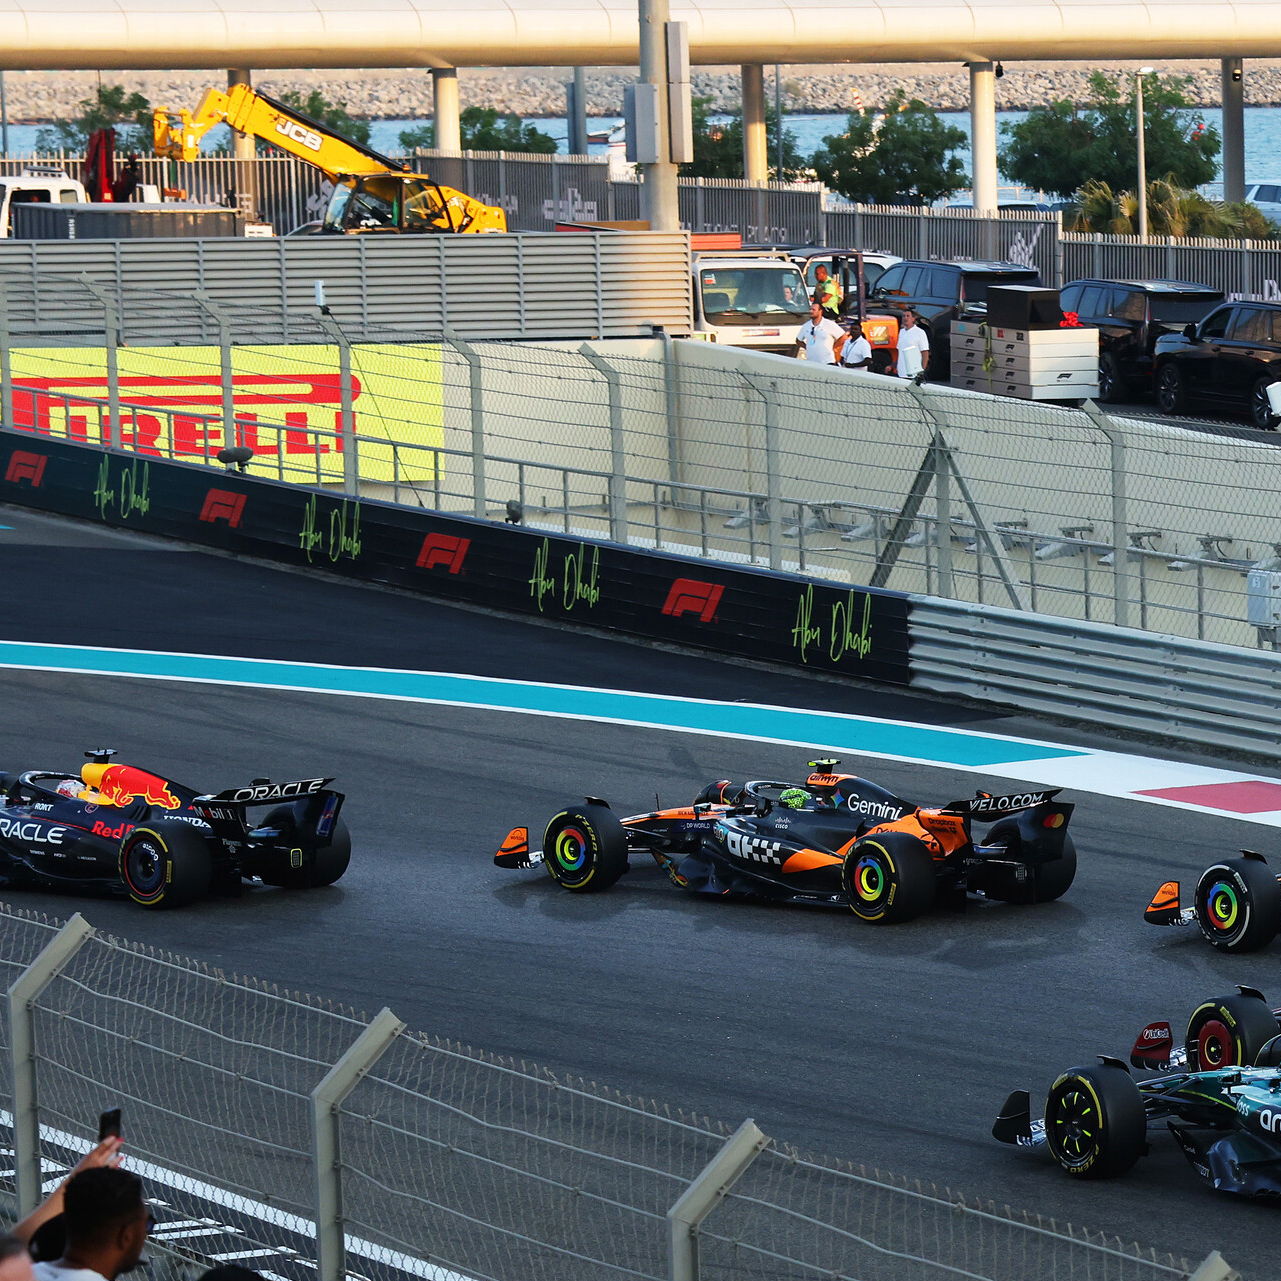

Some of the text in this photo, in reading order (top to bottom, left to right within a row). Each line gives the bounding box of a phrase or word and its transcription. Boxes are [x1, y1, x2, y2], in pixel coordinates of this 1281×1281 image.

[275, 118, 323, 151] JCB
[5, 450, 48, 487] F1
[198, 488, 248, 528] F1
[299, 493, 362, 563] Abu Dhabi
[415, 532, 472, 574] F1
[528, 537, 600, 612] Abu Dhabi
[661, 578, 726, 623] F1
[792, 583, 873, 663] Abu Dhabi
[234, 780, 324, 801] ORACLE
[847, 792, 903, 821] Gemini
[969, 792, 1045, 812] VELO.COM
[193, 806, 225, 820] Mobil
[0, 818, 67, 845] RACLE
[91, 820, 124, 840] Red
[1236, 1094, 1249, 1117] OSS
